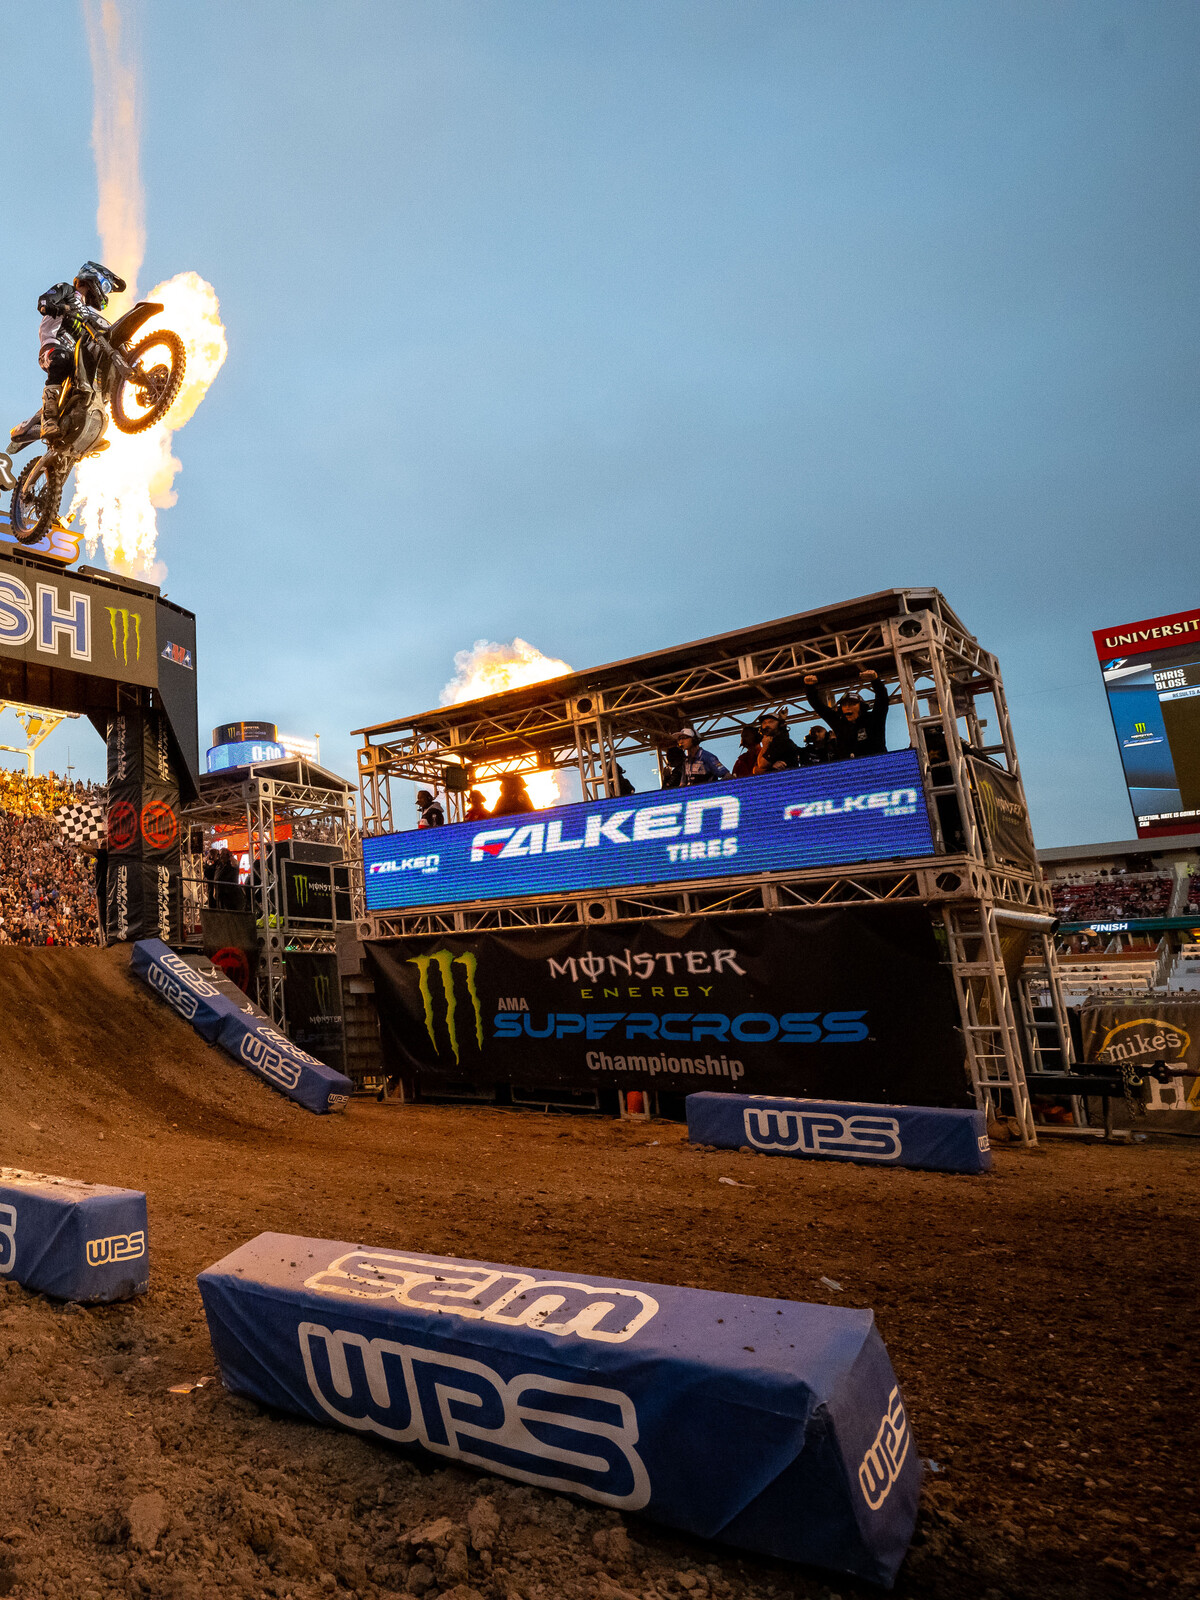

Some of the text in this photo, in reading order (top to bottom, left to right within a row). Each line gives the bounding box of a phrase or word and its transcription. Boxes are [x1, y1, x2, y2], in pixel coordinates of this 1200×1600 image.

[161, 640, 193, 668] AMA
[1153, 669, 1185, 682] CHRIS
[1155, 677, 1188, 691] BLOSE
[784, 787, 918, 820] FALKEN
[470, 795, 741, 863] FALKEN
[369, 854, 440, 874] FALKEN
[666, 837, 739, 863] TIRES
[309, 882, 340, 891] MONSTR
[1090, 923, 1128, 932] FINISH
[160, 953, 221, 998] WPS
[546, 948, 747, 983] MONSTER
[148, 961, 199, 1020] WPS
[497, 997, 530, 1011] AMA
[580, 986, 714, 999] ENERGY
[309, 1015, 342, 1024] MONSTER
[492, 1010, 870, 1043] SUPERCROSS
[240, 1032, 302, 1090] WPS
[257, 1026, 326, 1066] WPS
[1106, 1030, 1182, 1063] mike's
[585, 1051, 745, 1081] Championship
[743, 1107, 902, 1160] WPS
[86, 1230, 145, 1267] WPS
[304, 1250, 660, 1344] WPS
[297, 1320, 651, 1512] WPS
[858, 1384, 910, 1511] WPS
